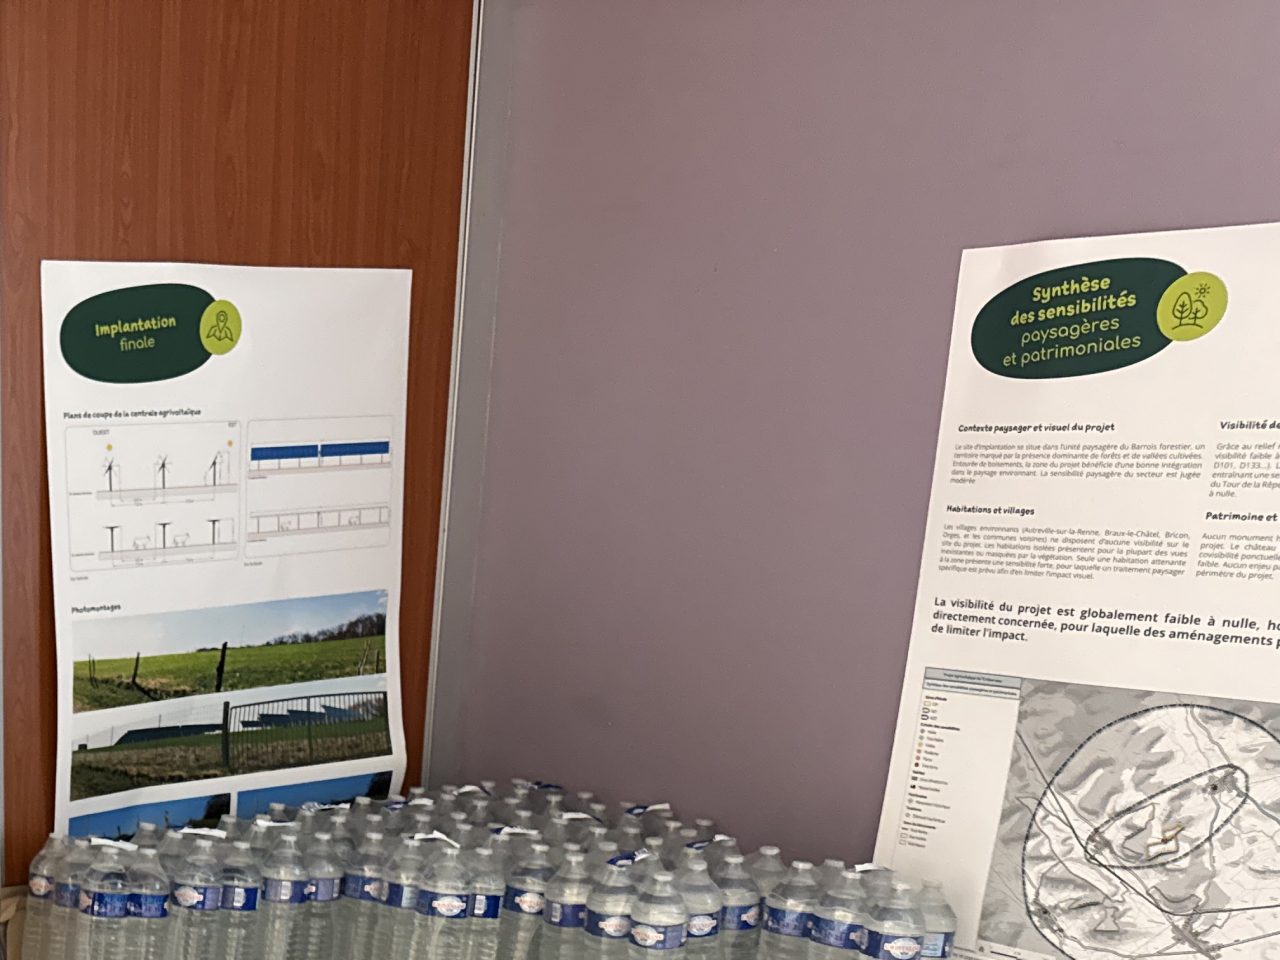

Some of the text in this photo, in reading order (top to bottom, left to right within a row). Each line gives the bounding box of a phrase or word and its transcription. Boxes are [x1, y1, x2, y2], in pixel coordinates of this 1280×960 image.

[1032, 277, 1111, 302] Synthèse
[1011, 290, 1137, 327] des sensibilités
[95, 315, 176, 338] Implantation
[1021, 318, 1120, 347] paysagères
[119, 336, 155, 352] finale
[1002, 334, 1142, 368] et patrimoniales
[93, 412, 112, 420] coupe
[1220, 420, 1268, 429] Visibilité
[994, 425, 1031, 433] paysager
[1071, 423, 1083, 431] du
[1085, 423, 1115, 432] projet
[947, 505, 991, 514] Habitations
[1003, 507, 1035, 516] villages
[1206, 512, 1278, 521] Patrimoine et
[935, 597, 946, 606] La
[951, 598, 994, 610] visibilité
[1000, 603, 1012, 612] du
[1018, 604, 1051, 616] projet
[1057, 607, 1075, 617] est
[1080, 608, 1158, 622] globalement
[1165, 613, 1201, 625] faible
[1208, 616, 1215, 626] à
[1222, 618, 1260, 631] nulle,
[932, 624, 1028, 641] de limiter l'impact.
[933, 610, 1272, 645] directement concernée, pour laquelle des aménagements
